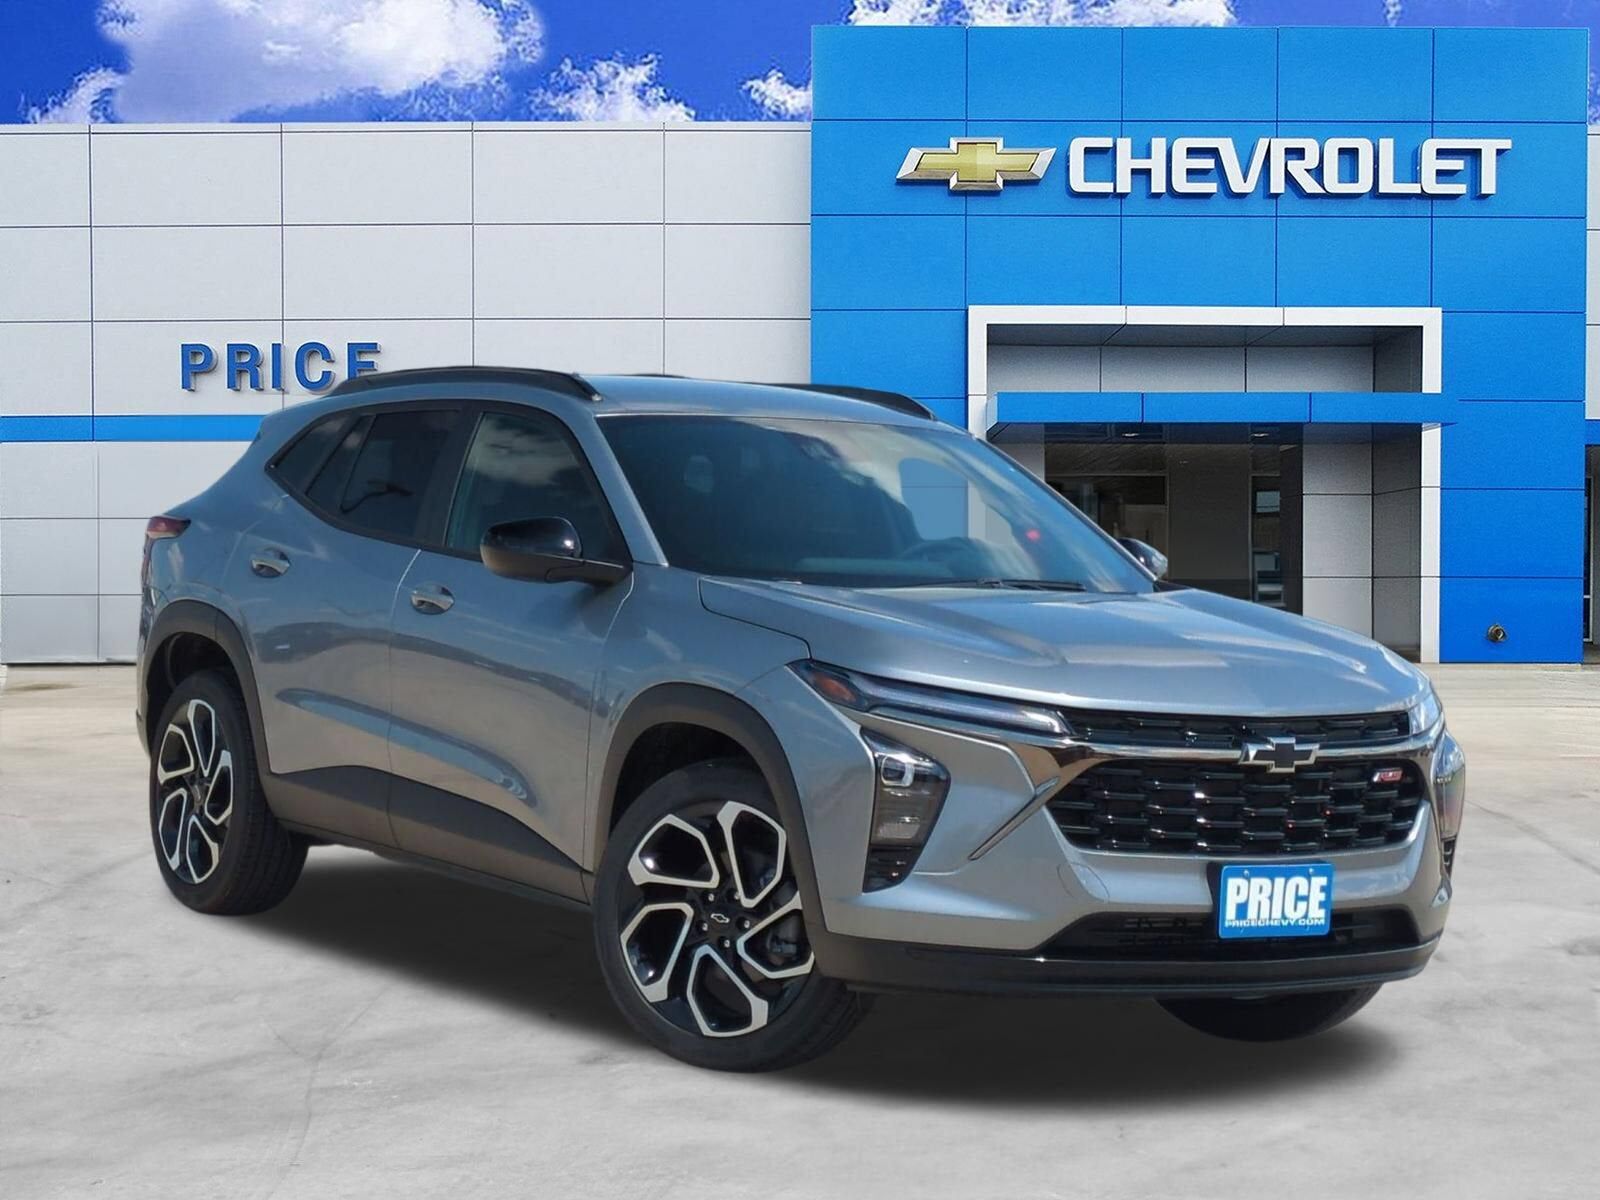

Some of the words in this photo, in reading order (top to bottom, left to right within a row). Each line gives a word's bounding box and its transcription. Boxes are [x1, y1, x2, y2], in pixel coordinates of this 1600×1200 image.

[1069, 137, 1512, 195] CHEVROLET
[180, 341, 381, 391] PRICE
[1225, 876, 1328, 920] PRICE
